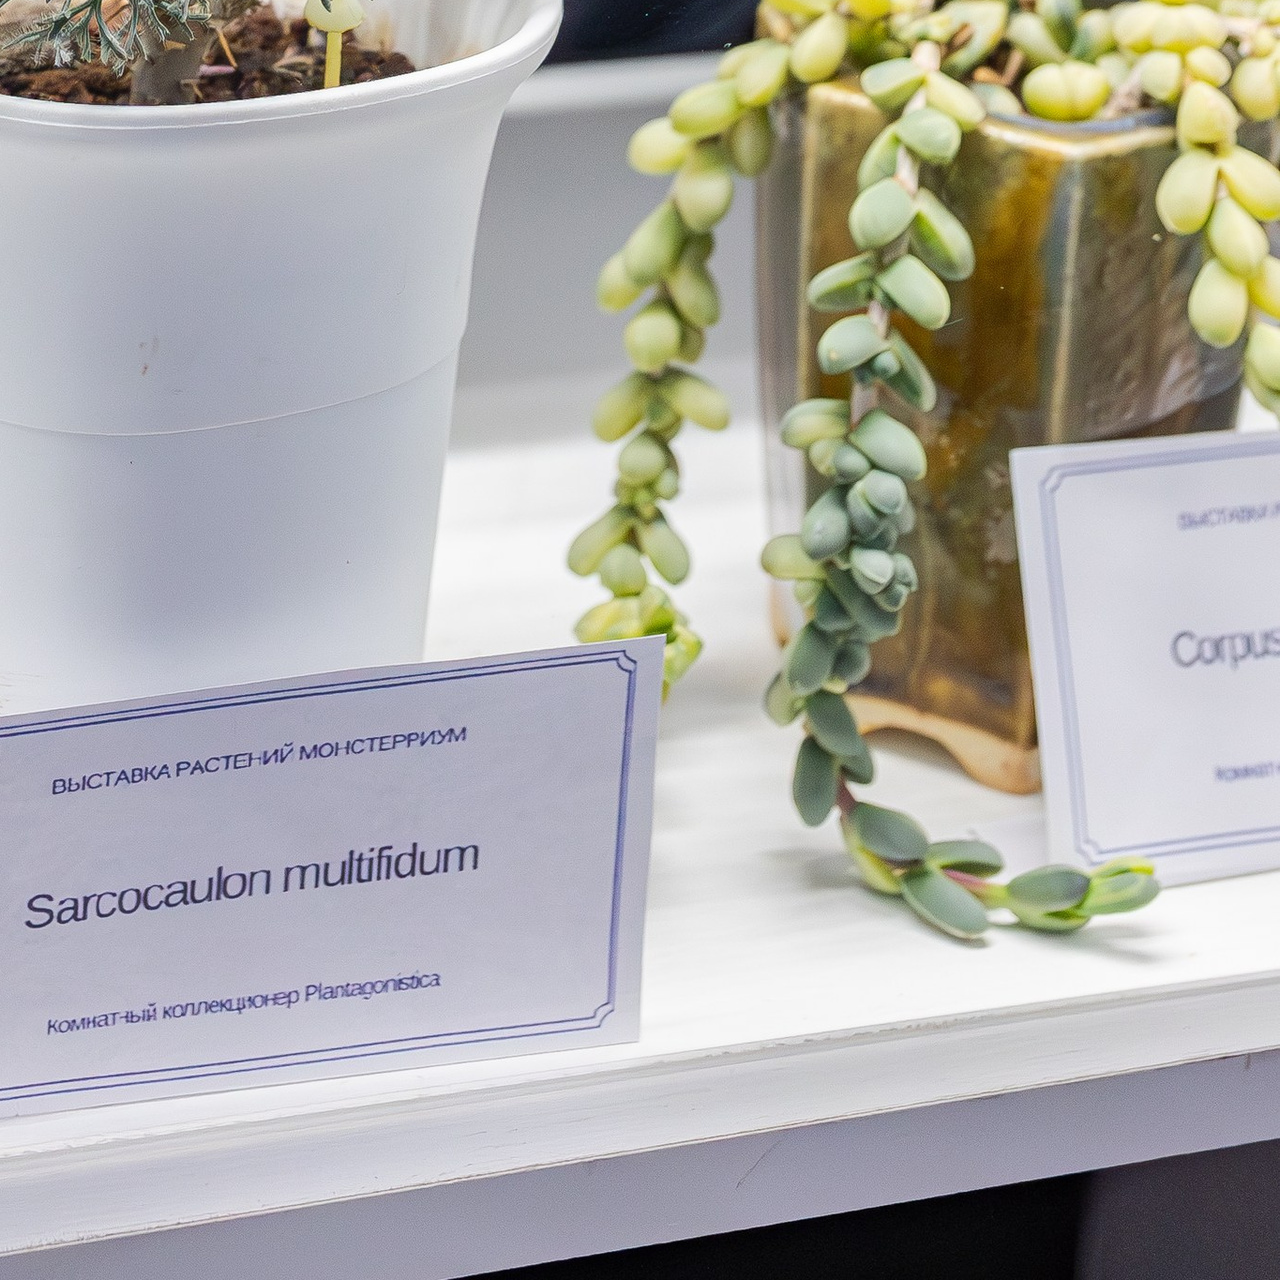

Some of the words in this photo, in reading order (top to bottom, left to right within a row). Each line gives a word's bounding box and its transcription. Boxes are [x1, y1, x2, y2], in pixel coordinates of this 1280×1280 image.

[52, 763, 171, 794] ВЫСТАВКА
[176, 741, 293, 778] РАСТЕНИЙ
[299, 726, 467, 761] МОНСТЕРРИУМ
[24, 866, 271, 929] Sarcocaulon
[282, 841, 480, 892] multifidum
[47, 1002, 158, 1034] Комнатный
[162, 988, 300, 1016] коллекционер
[305, 971, 441, 1001] Plantagonistica
